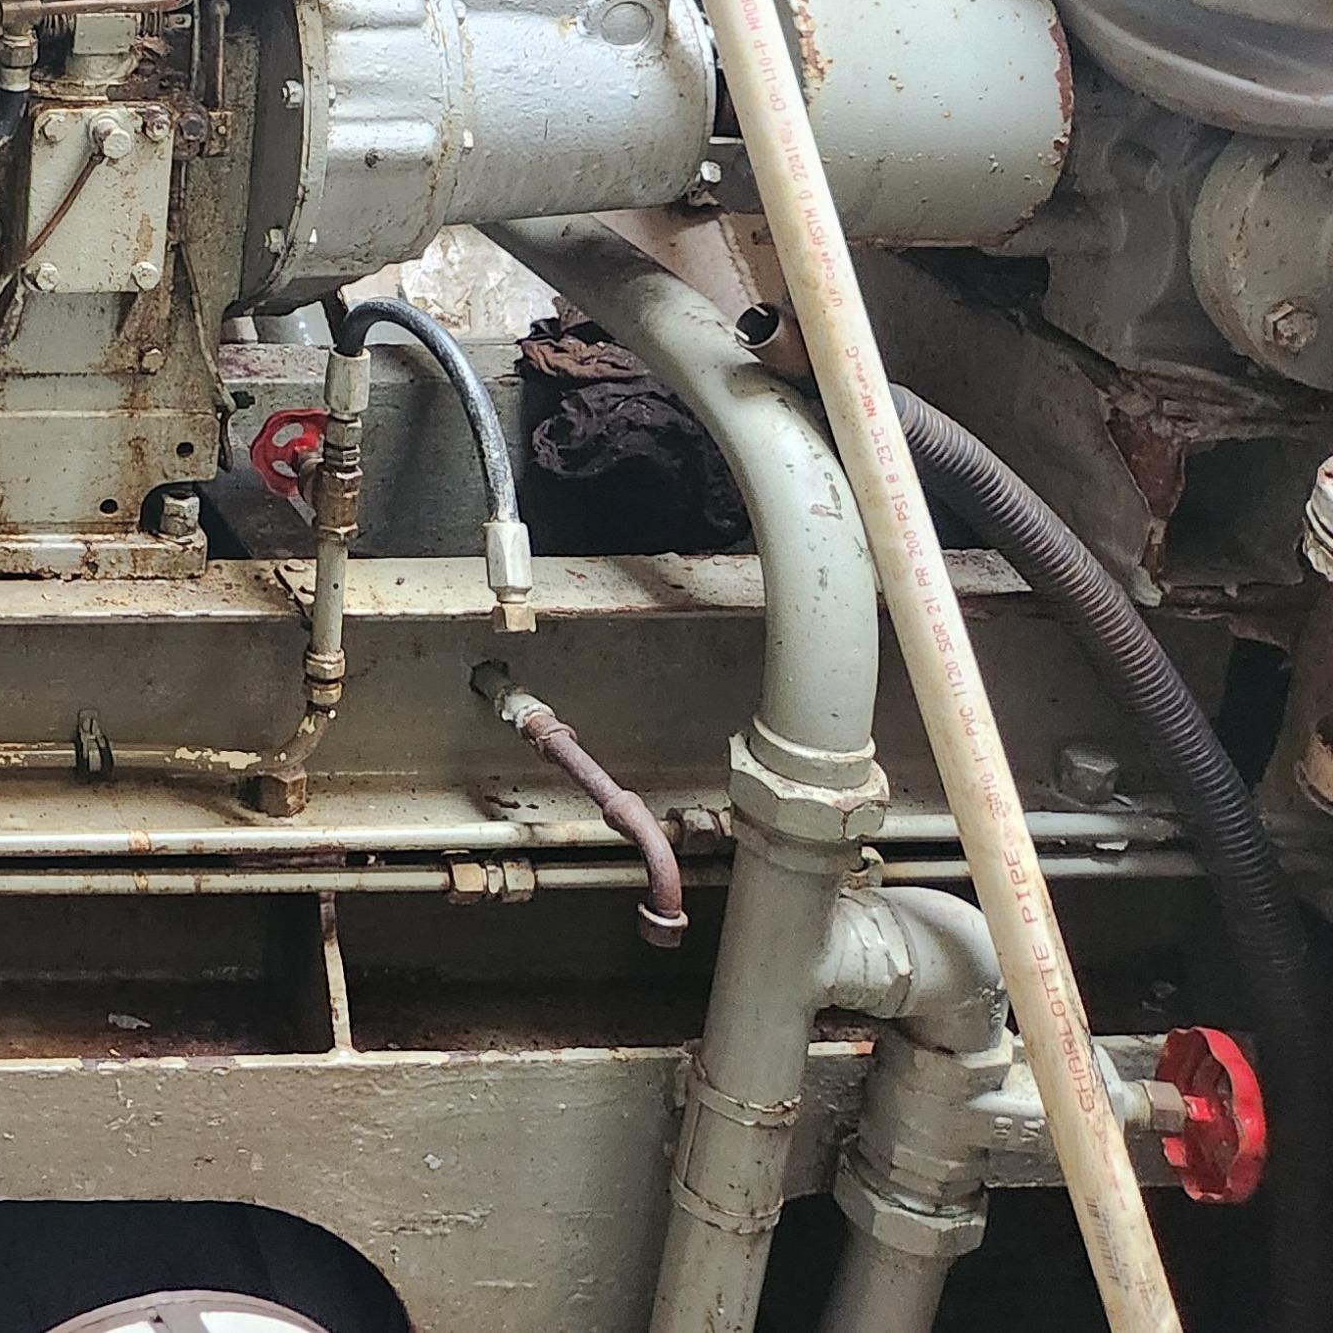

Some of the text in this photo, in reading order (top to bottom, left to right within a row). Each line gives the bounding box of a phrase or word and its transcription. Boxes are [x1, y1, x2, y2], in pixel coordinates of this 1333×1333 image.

[797, 188, 813, 200] D
[890, 492, 911, 522] PSI
[901, 528, 923, 559] 200
[913, 565, 932, 588] PR
[930, 620, 954, 653] SDR
[942, 658, 968, 698] 1120
[956, 704, 980, 738] PVC
[1001, 845, 1040, 925] PIPE
